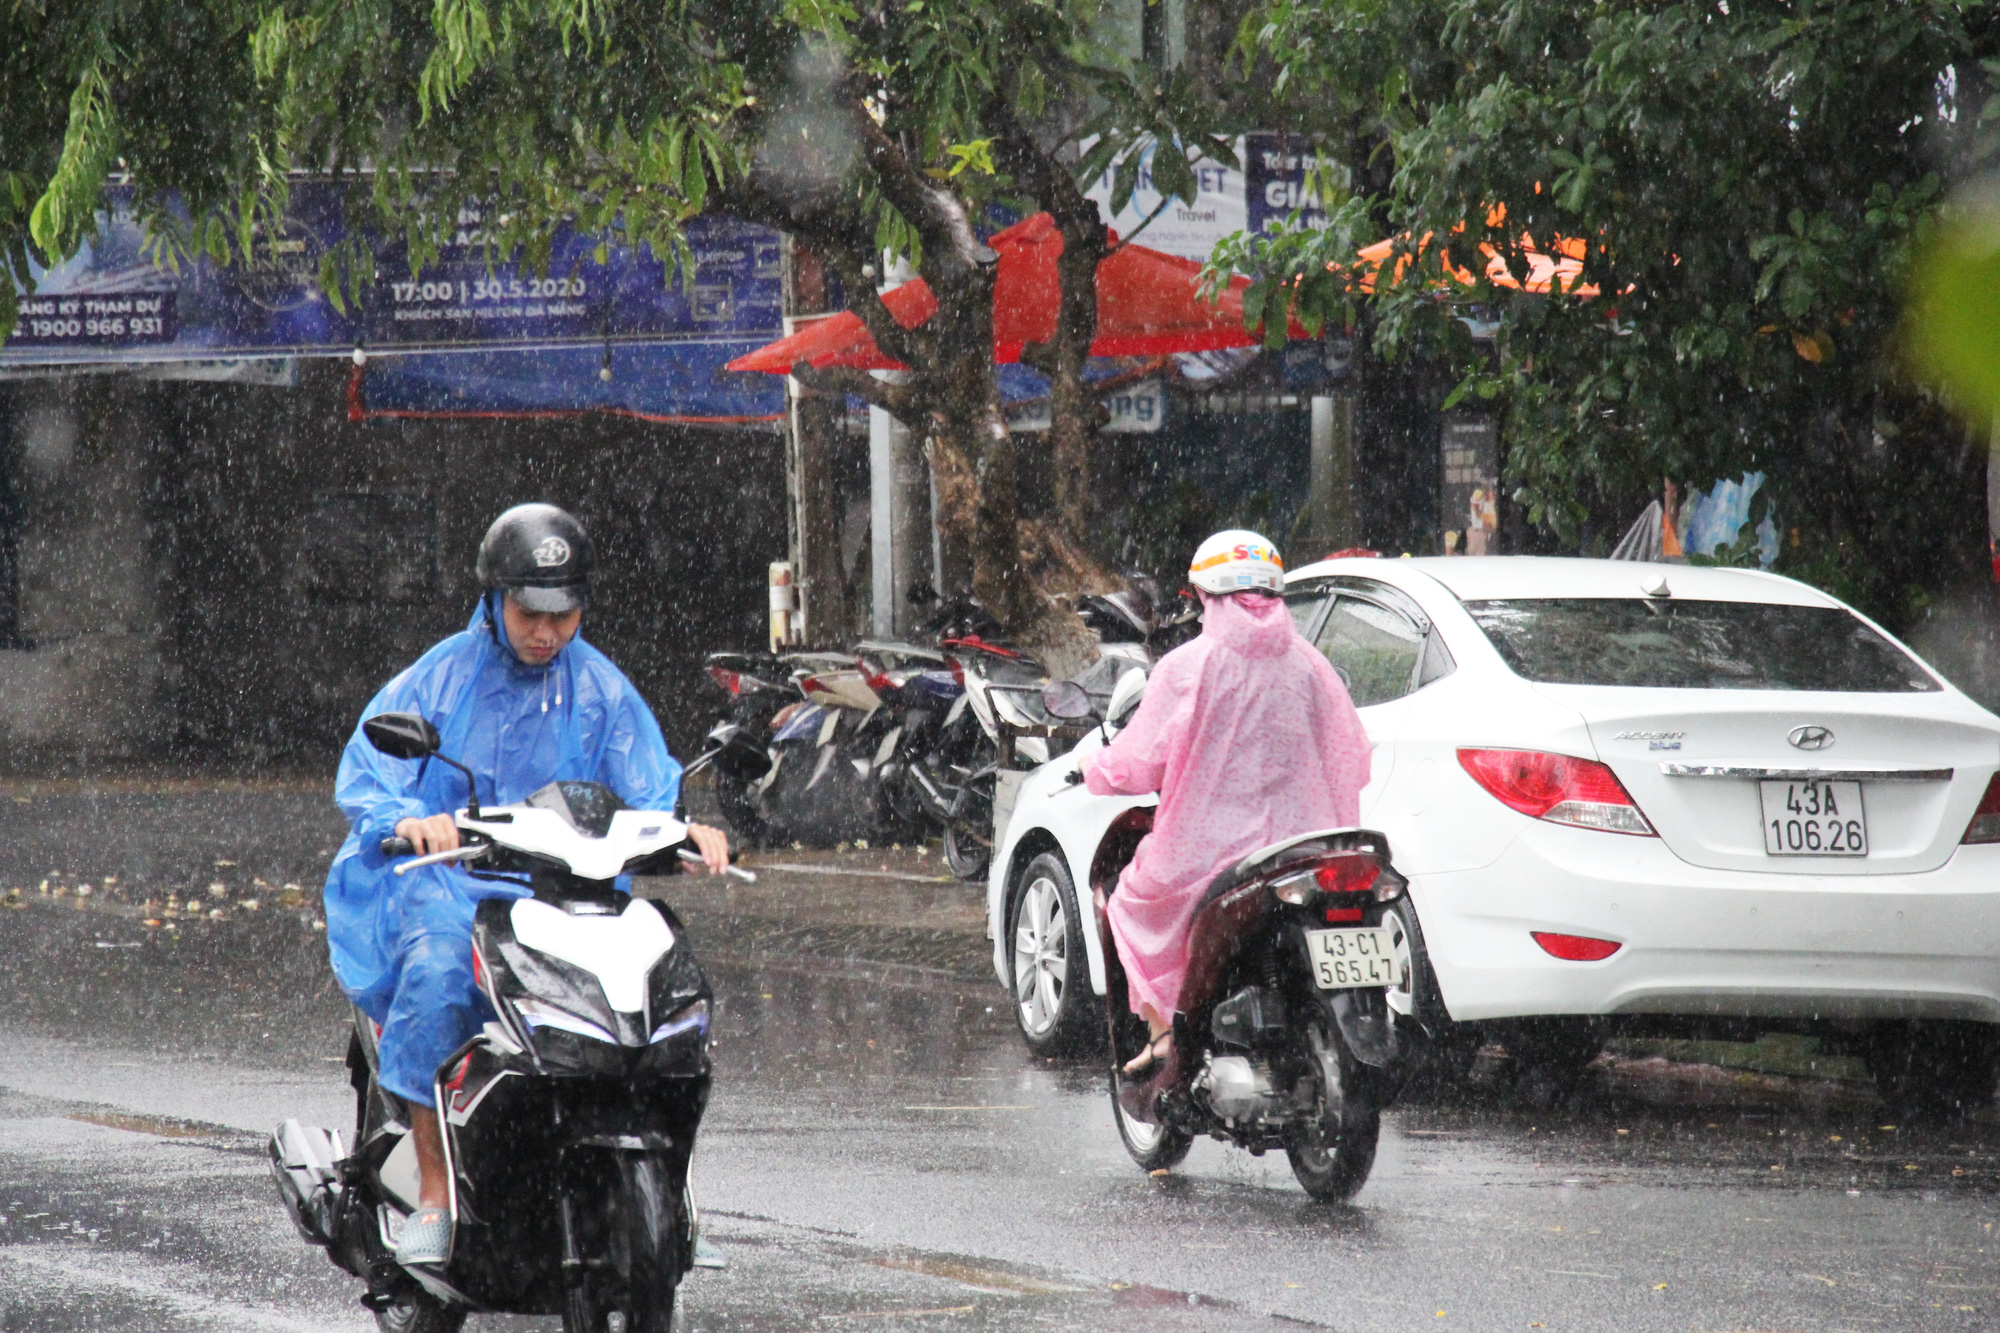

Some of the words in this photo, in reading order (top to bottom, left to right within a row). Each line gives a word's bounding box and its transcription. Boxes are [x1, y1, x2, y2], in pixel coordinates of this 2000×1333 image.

[1177, 208, 1216, 222] Travel
[391, 281, 452, 302] 17:00
[473, 278, 586, 301] 30.5.2020
[84, 299, 132, 314] THAM
[30, 319, 82, 337] 1900
[85, 318, 126, 336] 966
[130, 317, 163, 335] 931
[1613, 731, 1687, 741] ACCENT
[1649, 740, 1682, 751] blue
[1786, 784, 1839, 817] 43A
[1771, 819, 1863, 852] 106.26
[1319, 958, 1392, 985] 565.47
